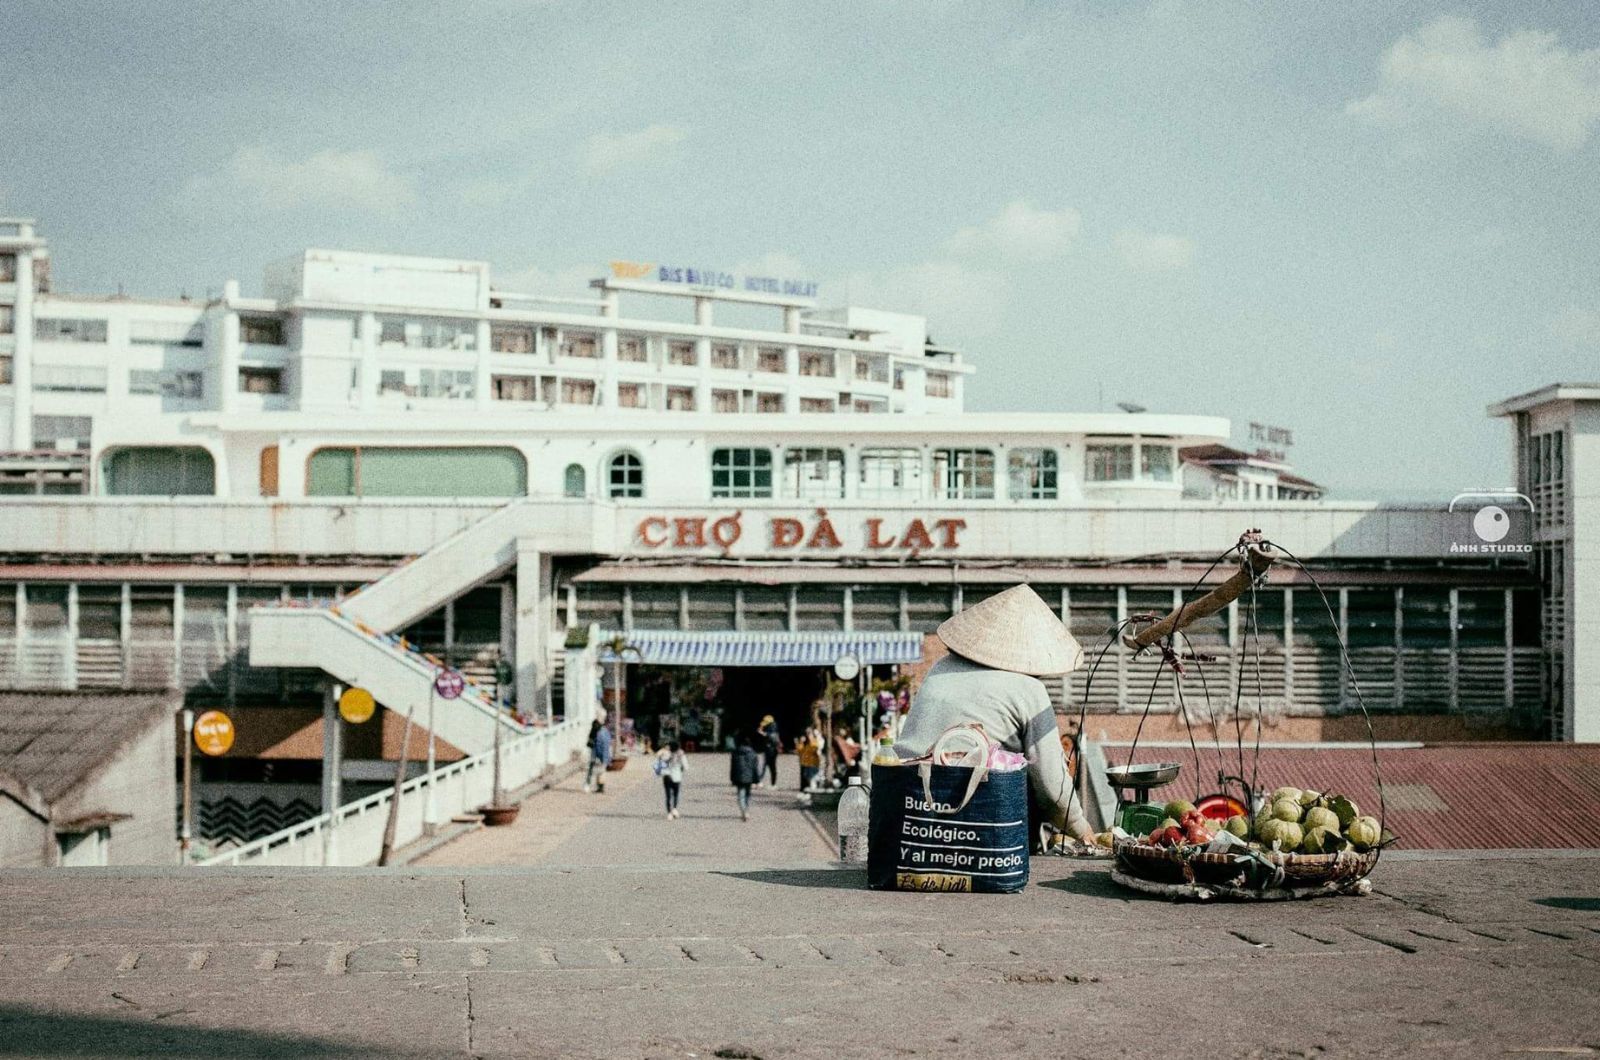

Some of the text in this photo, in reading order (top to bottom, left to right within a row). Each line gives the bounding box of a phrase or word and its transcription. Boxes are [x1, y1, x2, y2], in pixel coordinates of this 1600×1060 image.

[638, 507, 967, 559] CHỢ ĐÀ LẠT
[902, 821, 980, 842] Ecológico.
[899, 847, 1023, 870] Y al mejor precio.
